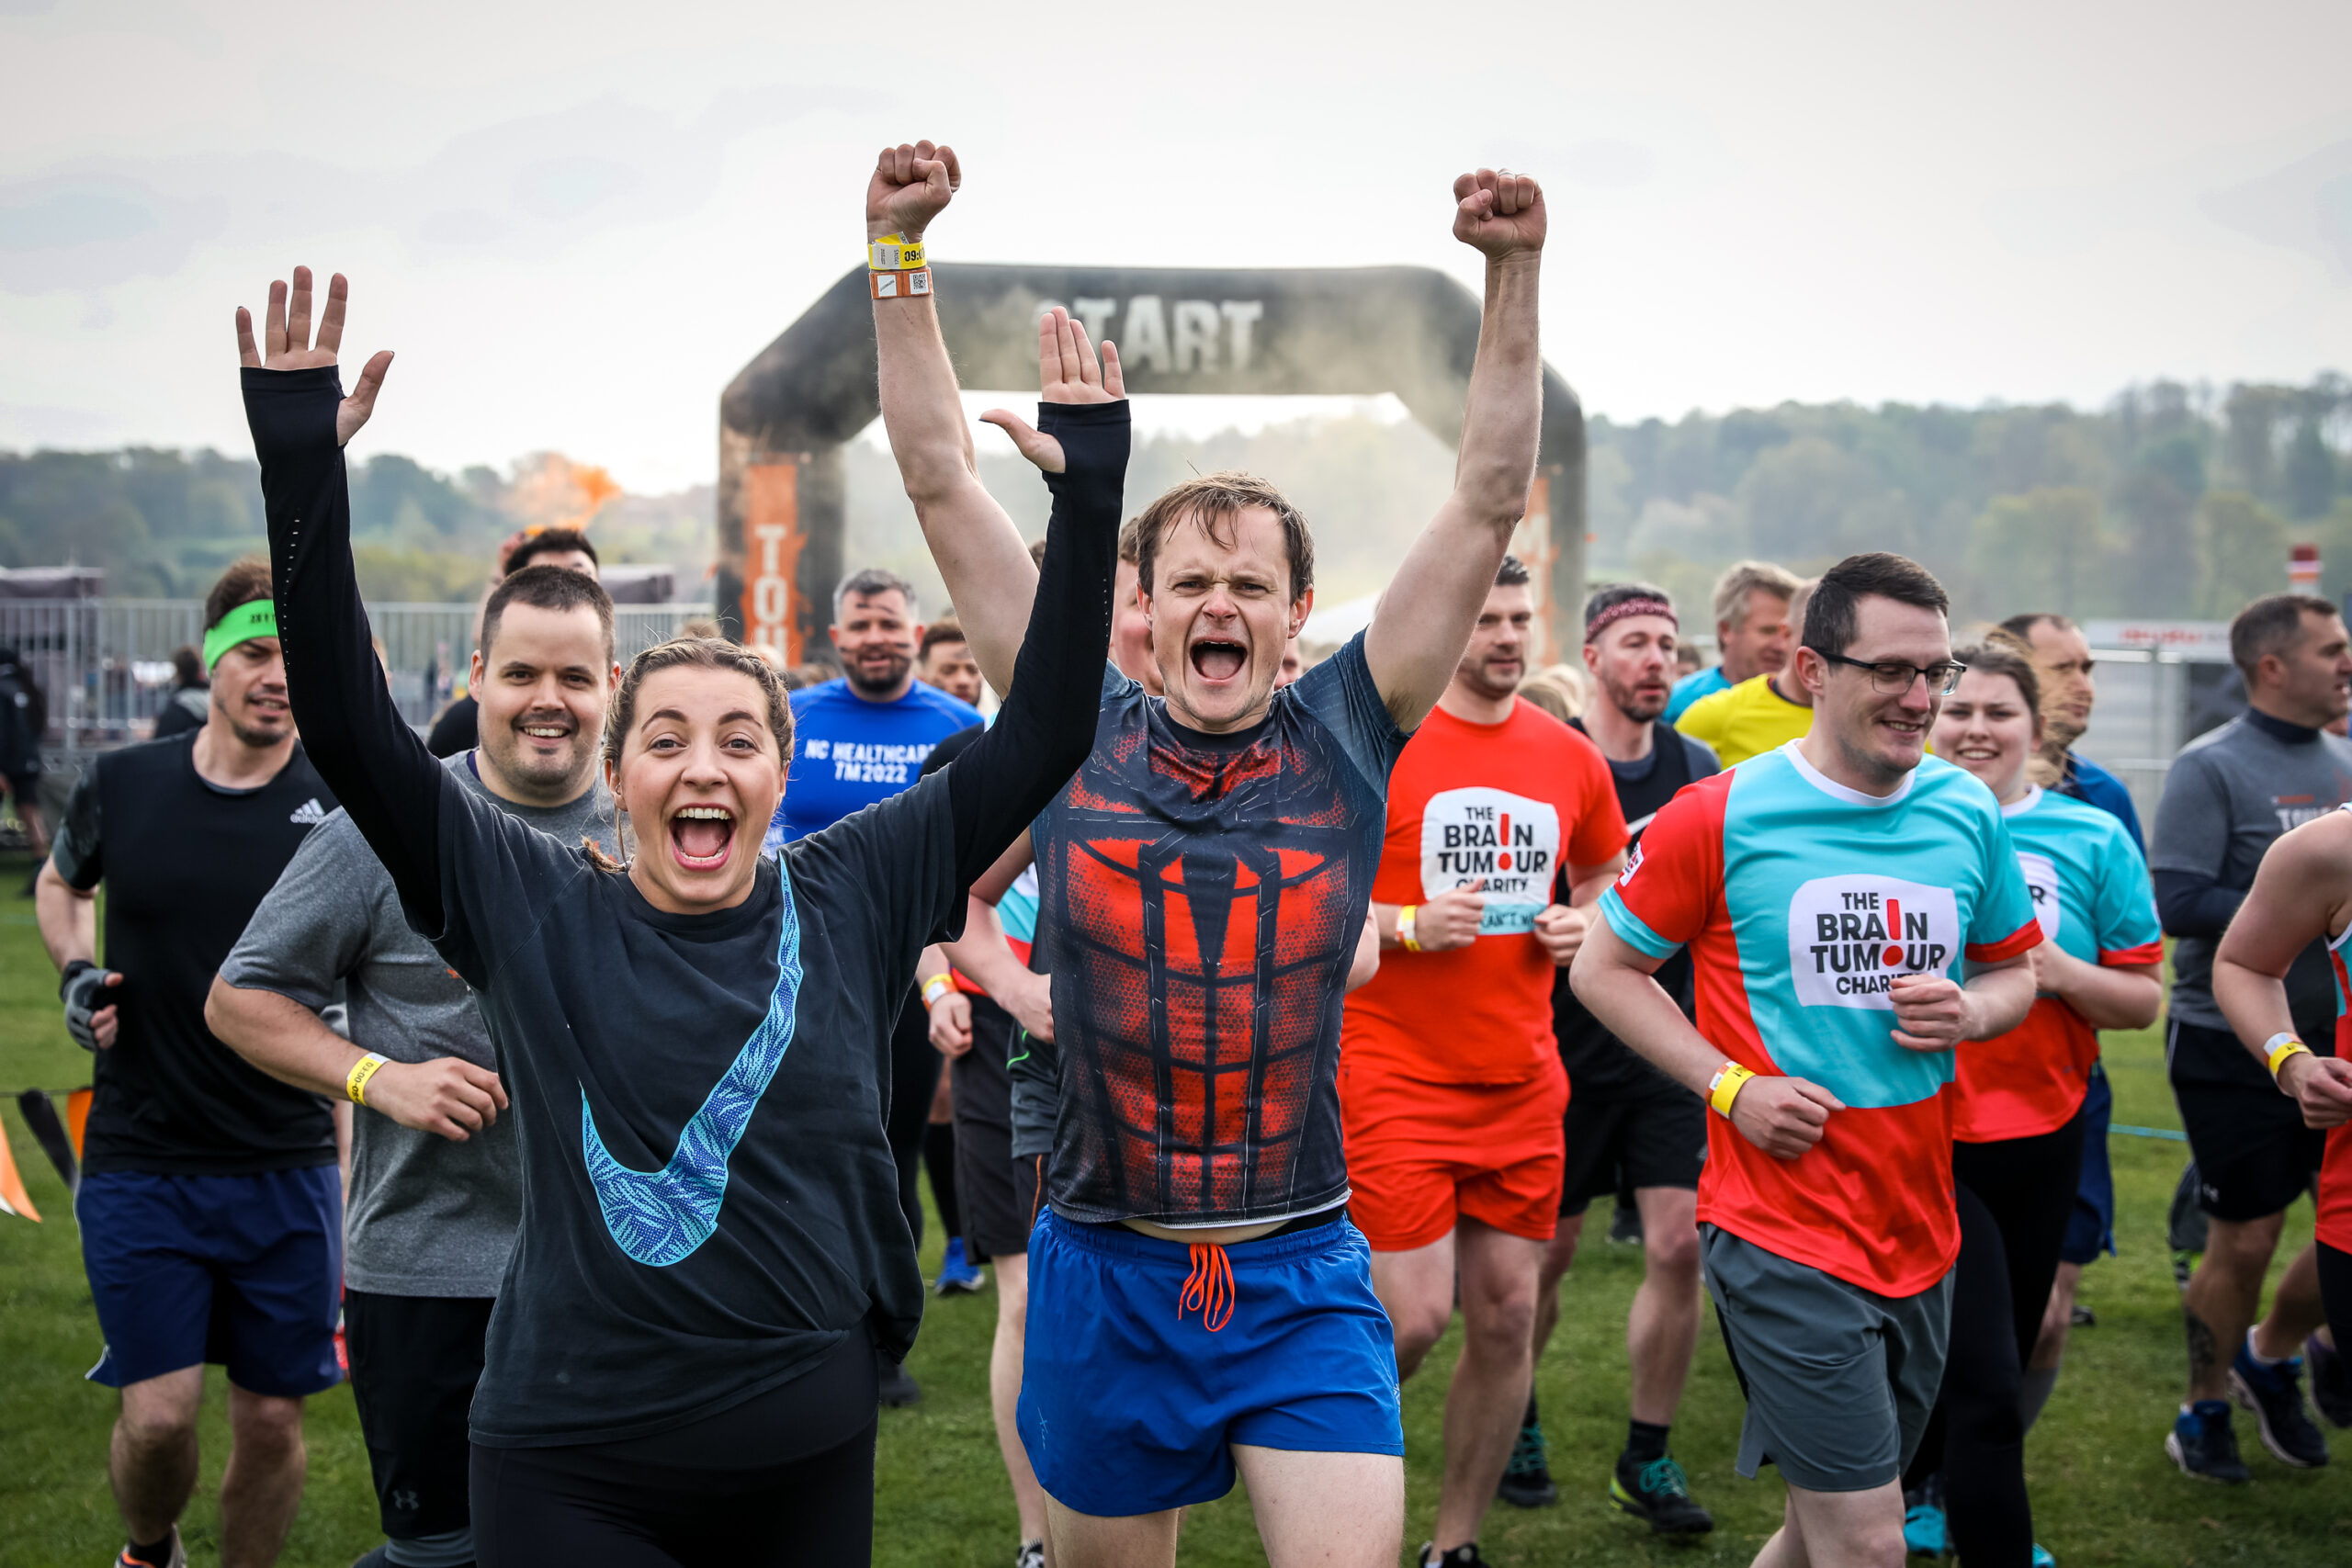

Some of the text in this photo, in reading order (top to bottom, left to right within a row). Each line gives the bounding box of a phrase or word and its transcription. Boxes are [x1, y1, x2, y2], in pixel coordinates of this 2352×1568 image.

[831, 741, 937, 764] HEALTHCAR
[1464, 807, 1494, 820] THE
[1456, 877, 1529, 893] CARITY
[1841, 892, 1880, 910] THE
[1836, 973, 1920, 996] CHAR
